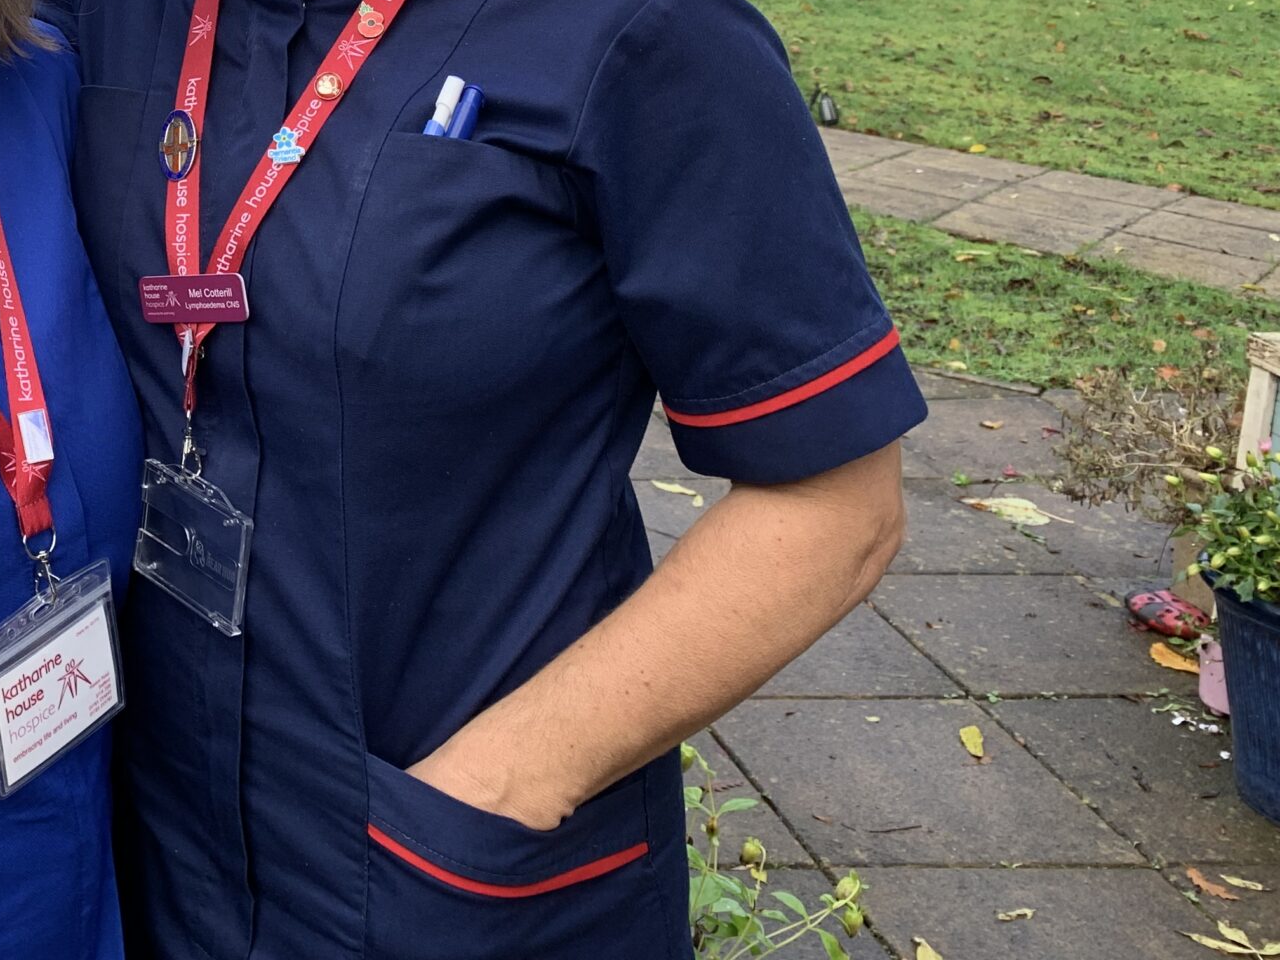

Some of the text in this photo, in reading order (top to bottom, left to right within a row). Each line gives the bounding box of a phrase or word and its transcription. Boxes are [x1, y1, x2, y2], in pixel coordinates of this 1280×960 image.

[216, 99, 322, 275] tharine house spice
[172, 179, 190, 276] use hospice
[185, 300, 240, 311] Lymphoedema CNS
[188, 288, 202, 298] Mel
[8, 315, 33, 402] katharine
[1, 653, 62, 703] katharine
[5, 689, 45, 723] house
[9, 703, 55, 744] hospice
[13, 738, 43, 763] embracing
[53, 721, 64, 734] and
[64, 711, 78, 726] living
